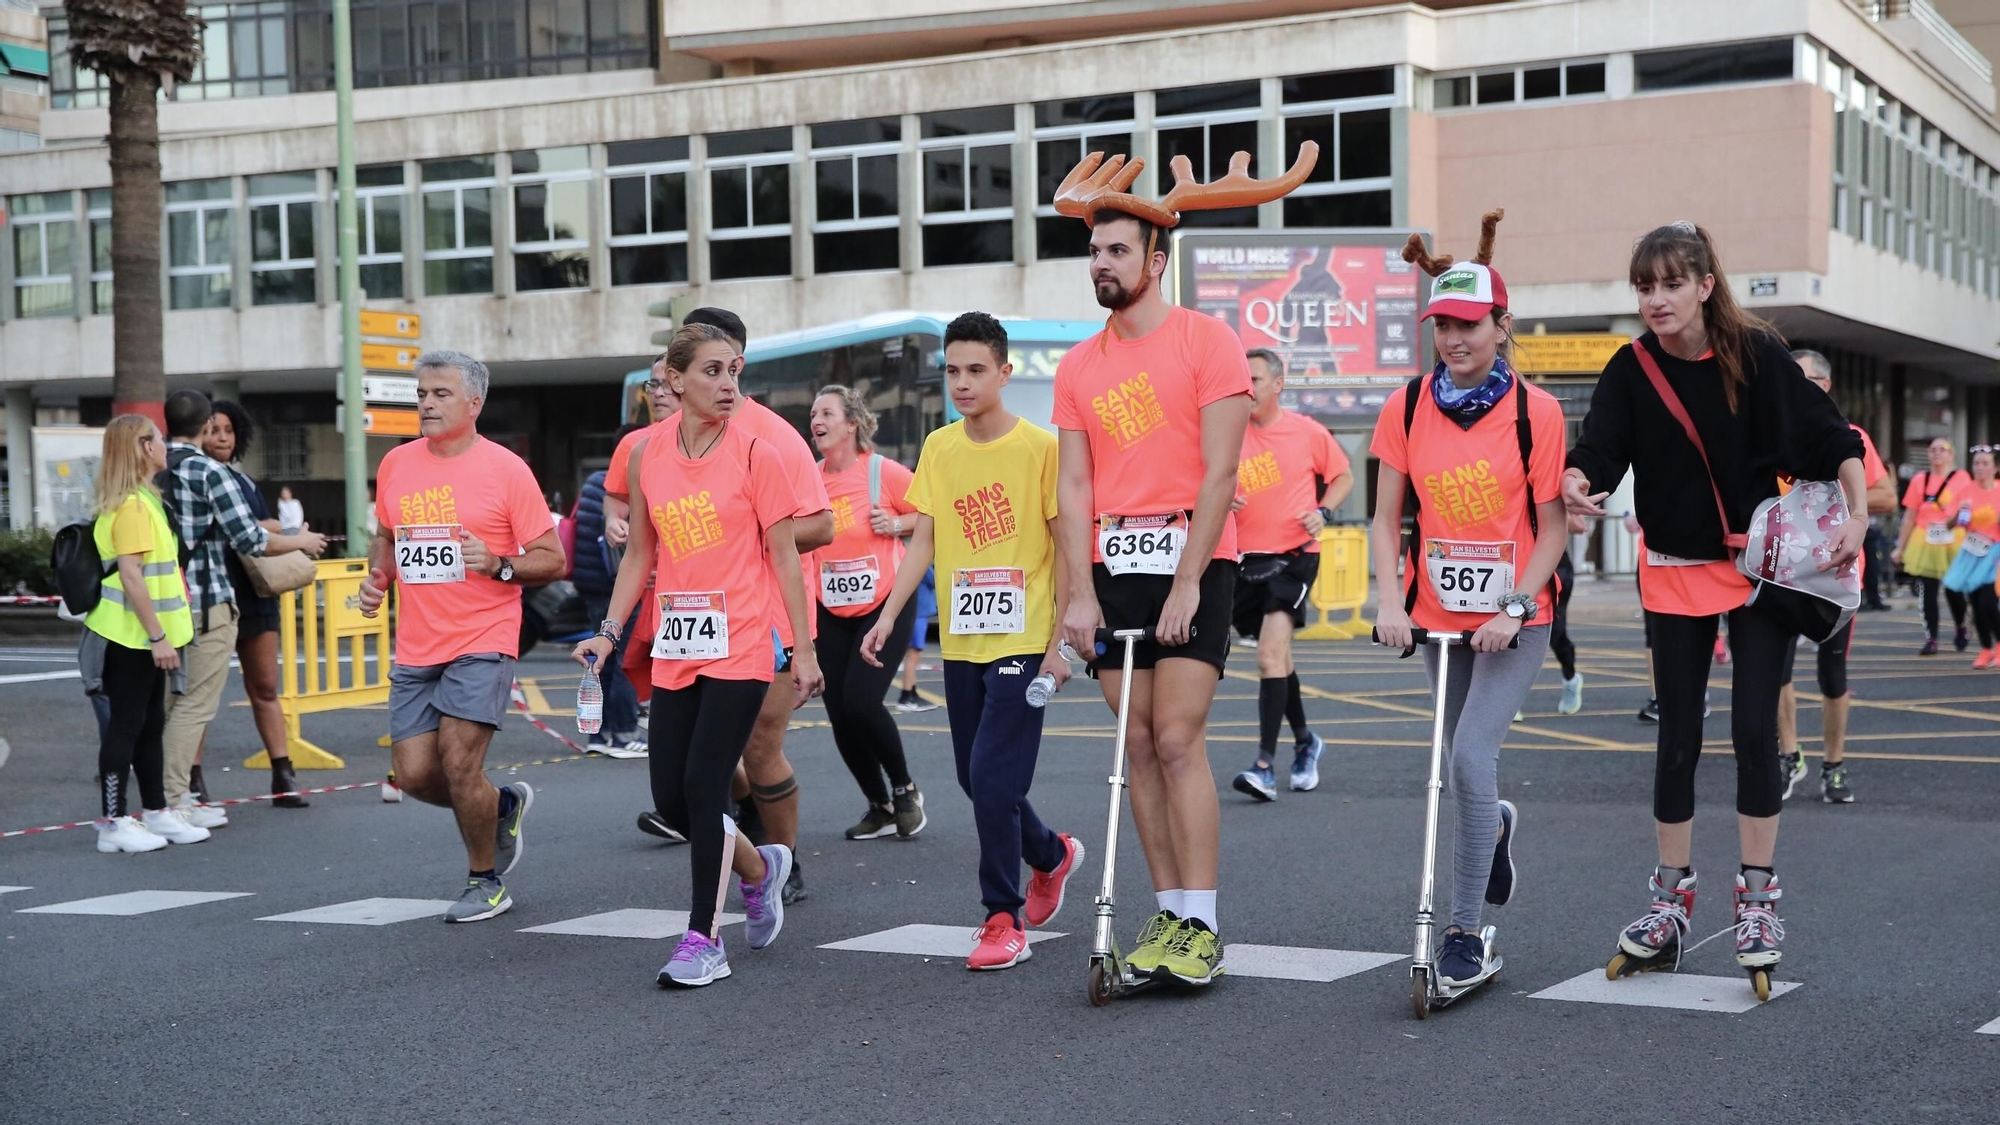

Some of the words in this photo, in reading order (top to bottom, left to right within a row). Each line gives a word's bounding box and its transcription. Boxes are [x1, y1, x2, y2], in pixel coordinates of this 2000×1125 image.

[1195, 247, 1245, 264] WORLD
[1246, 247, 1290, 264] MUSIC
[1438, 272, 1474, 286] Santas
[1245, 297, 1368, 342] QUEEN
[1091, 371, 1149, 415] SANS
[1424, 459, 1490, 494] SANS
[652, 490, 711, 524] SANS
[953, 482, 1004, 516] SANS
[401, 545, 455, 568] 2456
[1105, 532, 1174, 558] 6364
[1768, 536, 1780, 572] Boomerang
[826, 574, 873, 594] 4692
[1440, 566, 1494, 592] 567
[958, 592, 1013, 616] 2075
[661, 616, 716, 641] 2074
[998, 667, 1021, 675] PUMA
